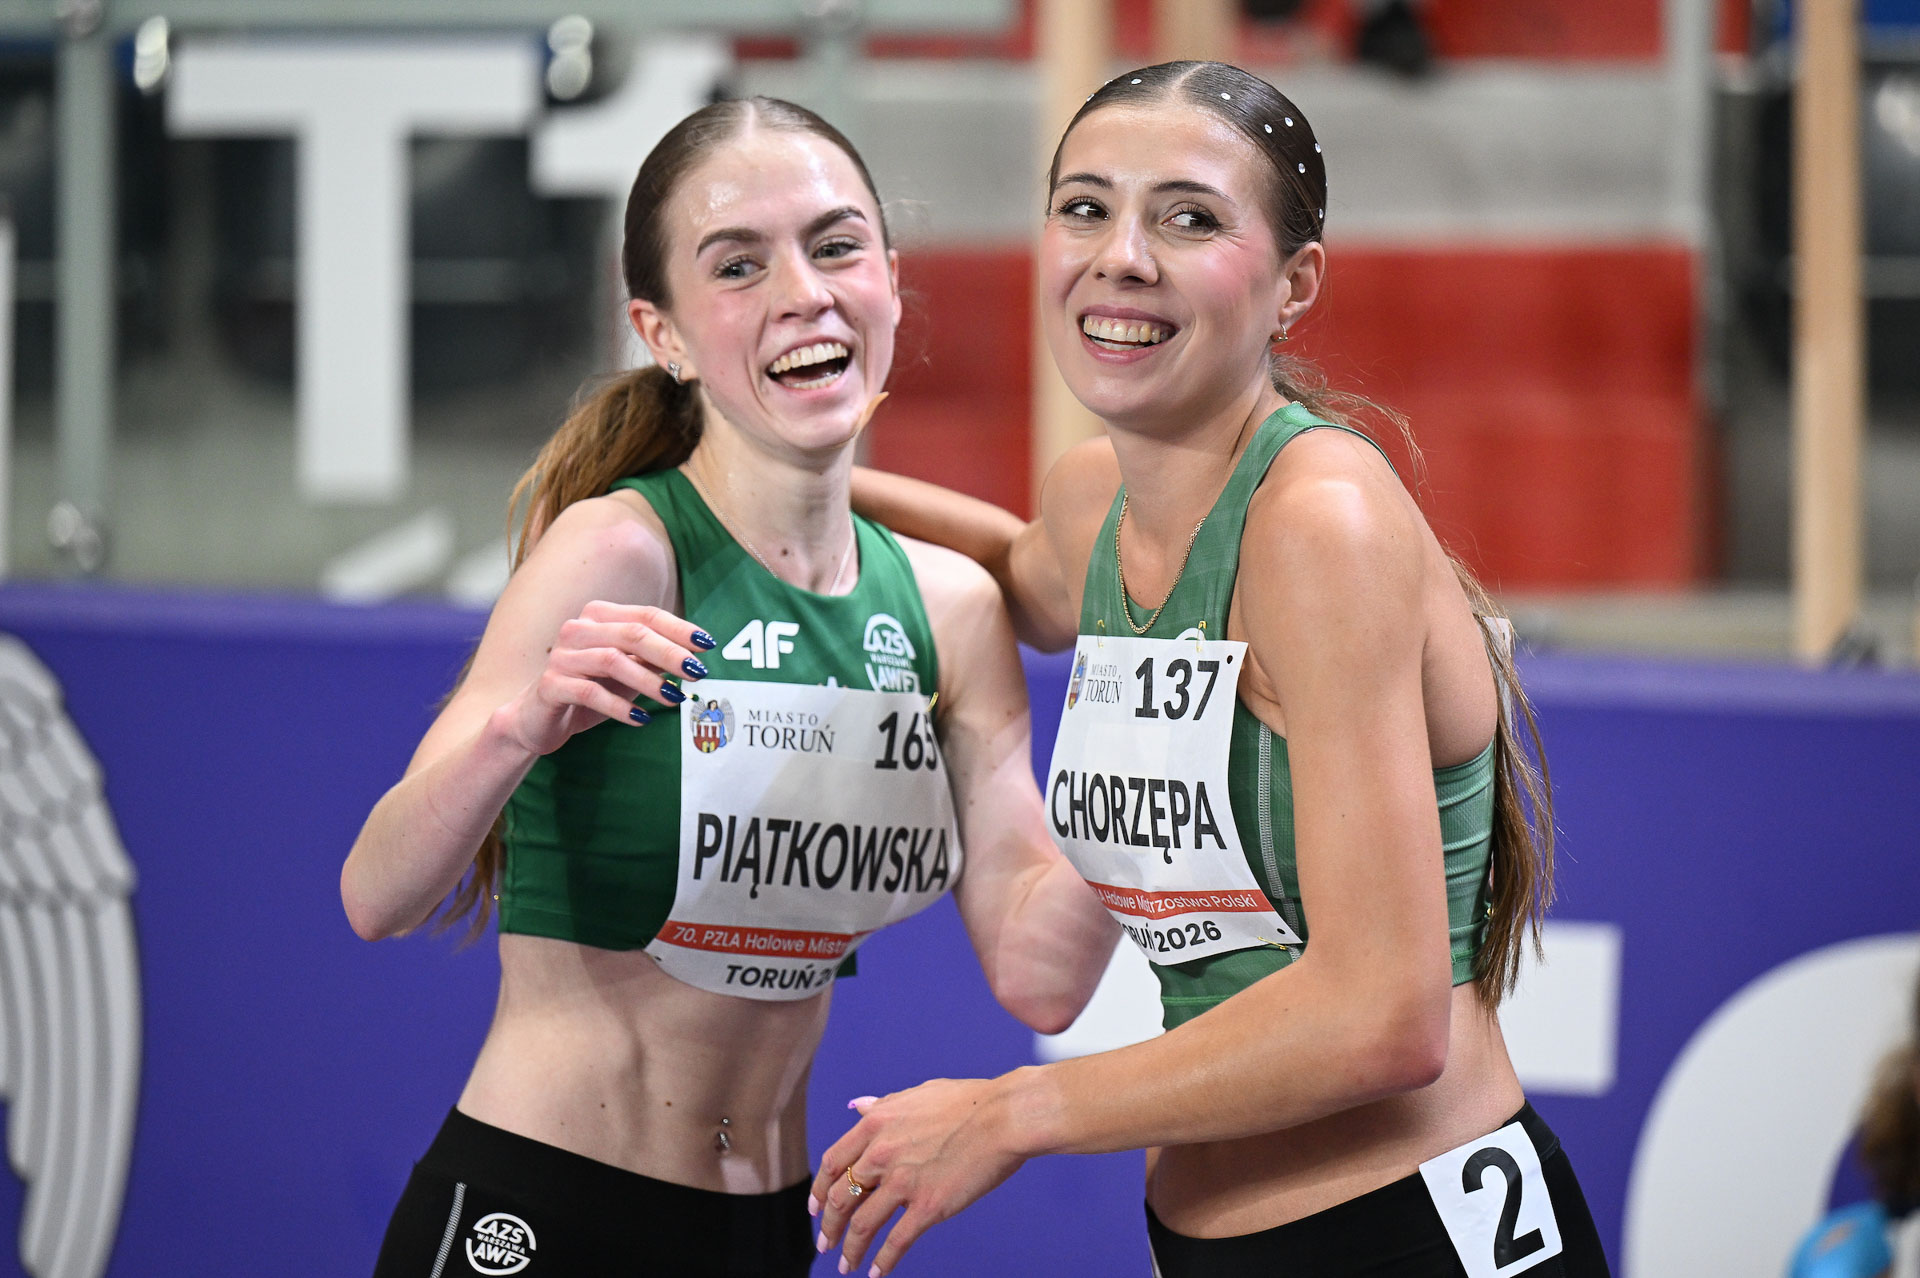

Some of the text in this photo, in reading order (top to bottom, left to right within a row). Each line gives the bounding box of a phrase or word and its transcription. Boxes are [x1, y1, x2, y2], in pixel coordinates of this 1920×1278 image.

[722, 619, 800, 669] 4F
[867, 628, 906, 656] AZS
[876, 664, 913, 693] AWF
[1091, 663, 1118, 677] MIASTO
[1085, 674, 1123, 703] TORUŃ
[1135, 657, 1220, 720] 137
[748, 709, 819, 726] MIASTO
[743, 723, 835, 753] TORUŃ
[874, 711, 938, 772] 165
[1051, 769, 1228, 864] CHORZĘPA
[693, 812, 950, 899] PIĄTKOWSKA
[1212, 894, 1258, 909] Polski
[673, 926, 697, 944] 70.
[702, 930, 740, 949] PZLA
[744, 933, 806, 952] Halowe
[1154, 920, 1222, 953] 2026
[726, 963, 815, 989] TORUŃ
[1462, 1147, 1545, 1270] 2
[476, 1232, 526, 1255] WARSZAWA
[484, 1220, 525, 1244] AZS
[473, 1242, 521, 1266] AWF
